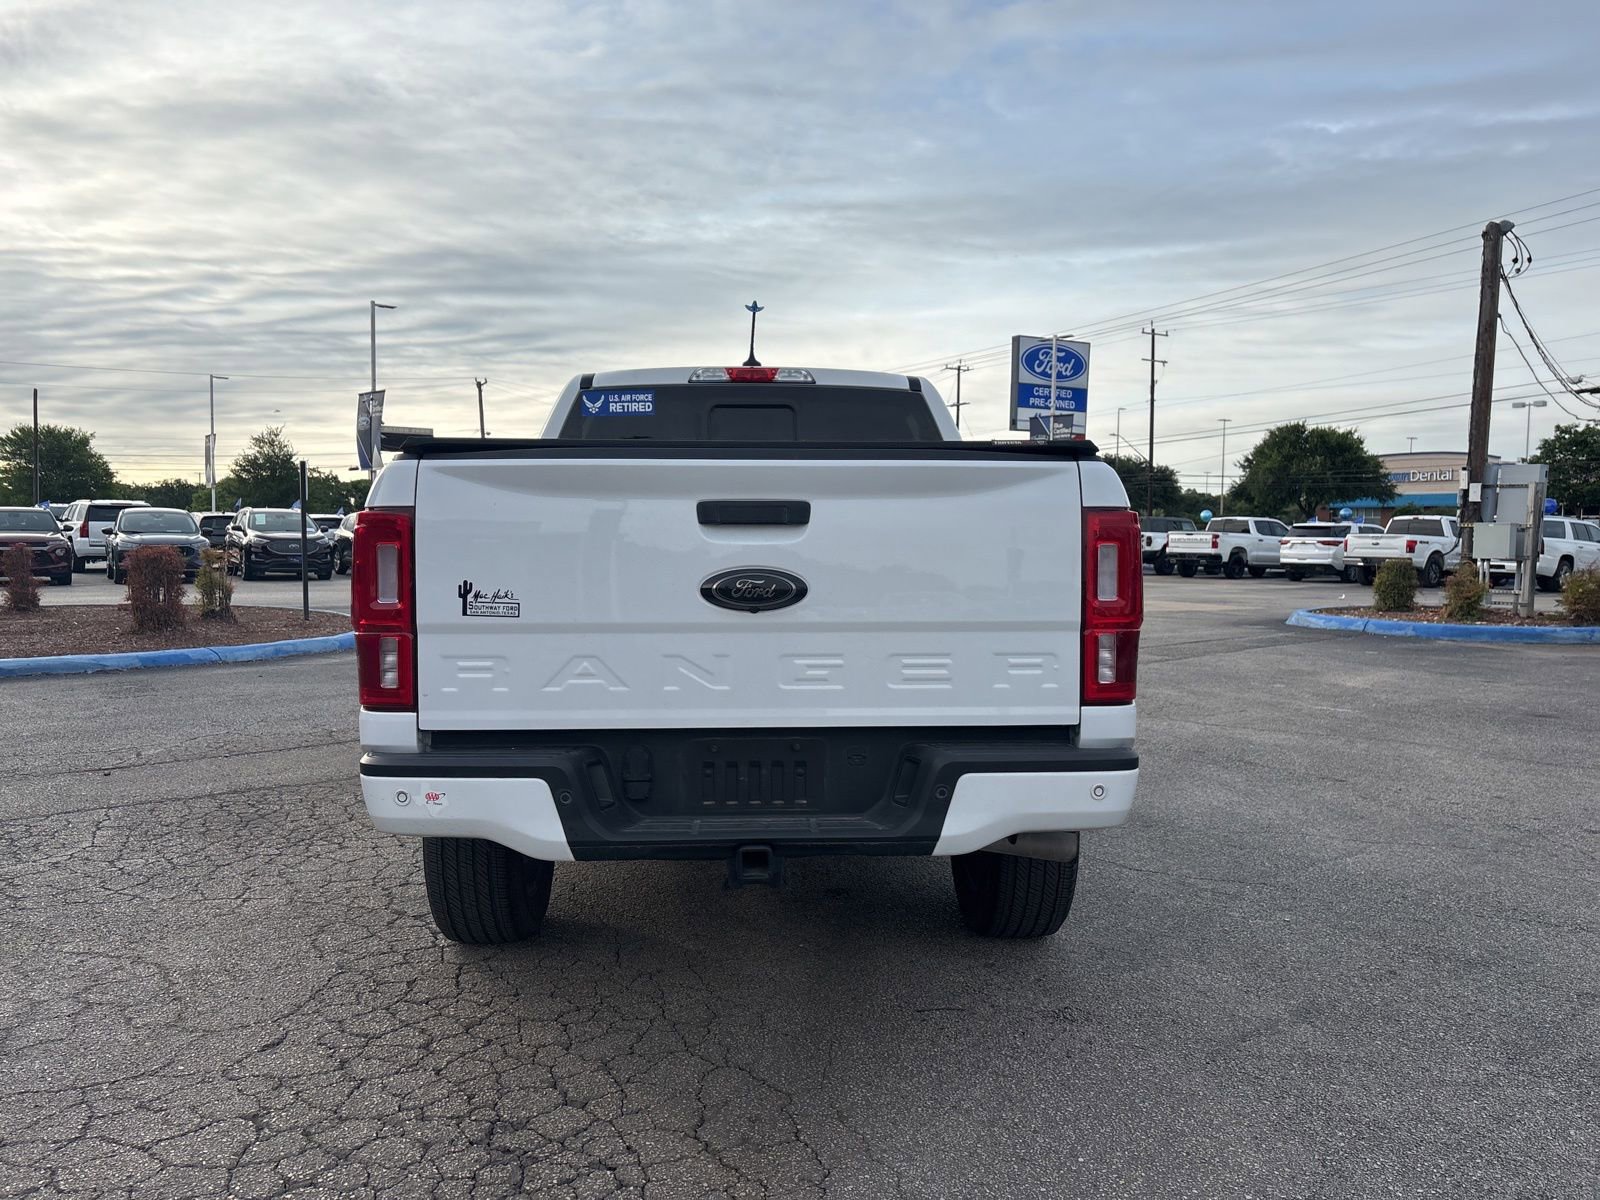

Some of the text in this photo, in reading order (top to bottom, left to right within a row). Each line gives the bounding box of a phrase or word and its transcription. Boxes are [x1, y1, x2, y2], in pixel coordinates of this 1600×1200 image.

[1034, 348, 1075, 376] Ford
[1033, 387, 1073, 398] CERFIED
[609, 402, 653, 412] RETIRED
[1410, 468, 1453, 481] Dental
[731, 579, 777, 598] Ford
[468, 601, 501, 611] SOUTHWAY
[440, 652, 1060, 691] RANGER
